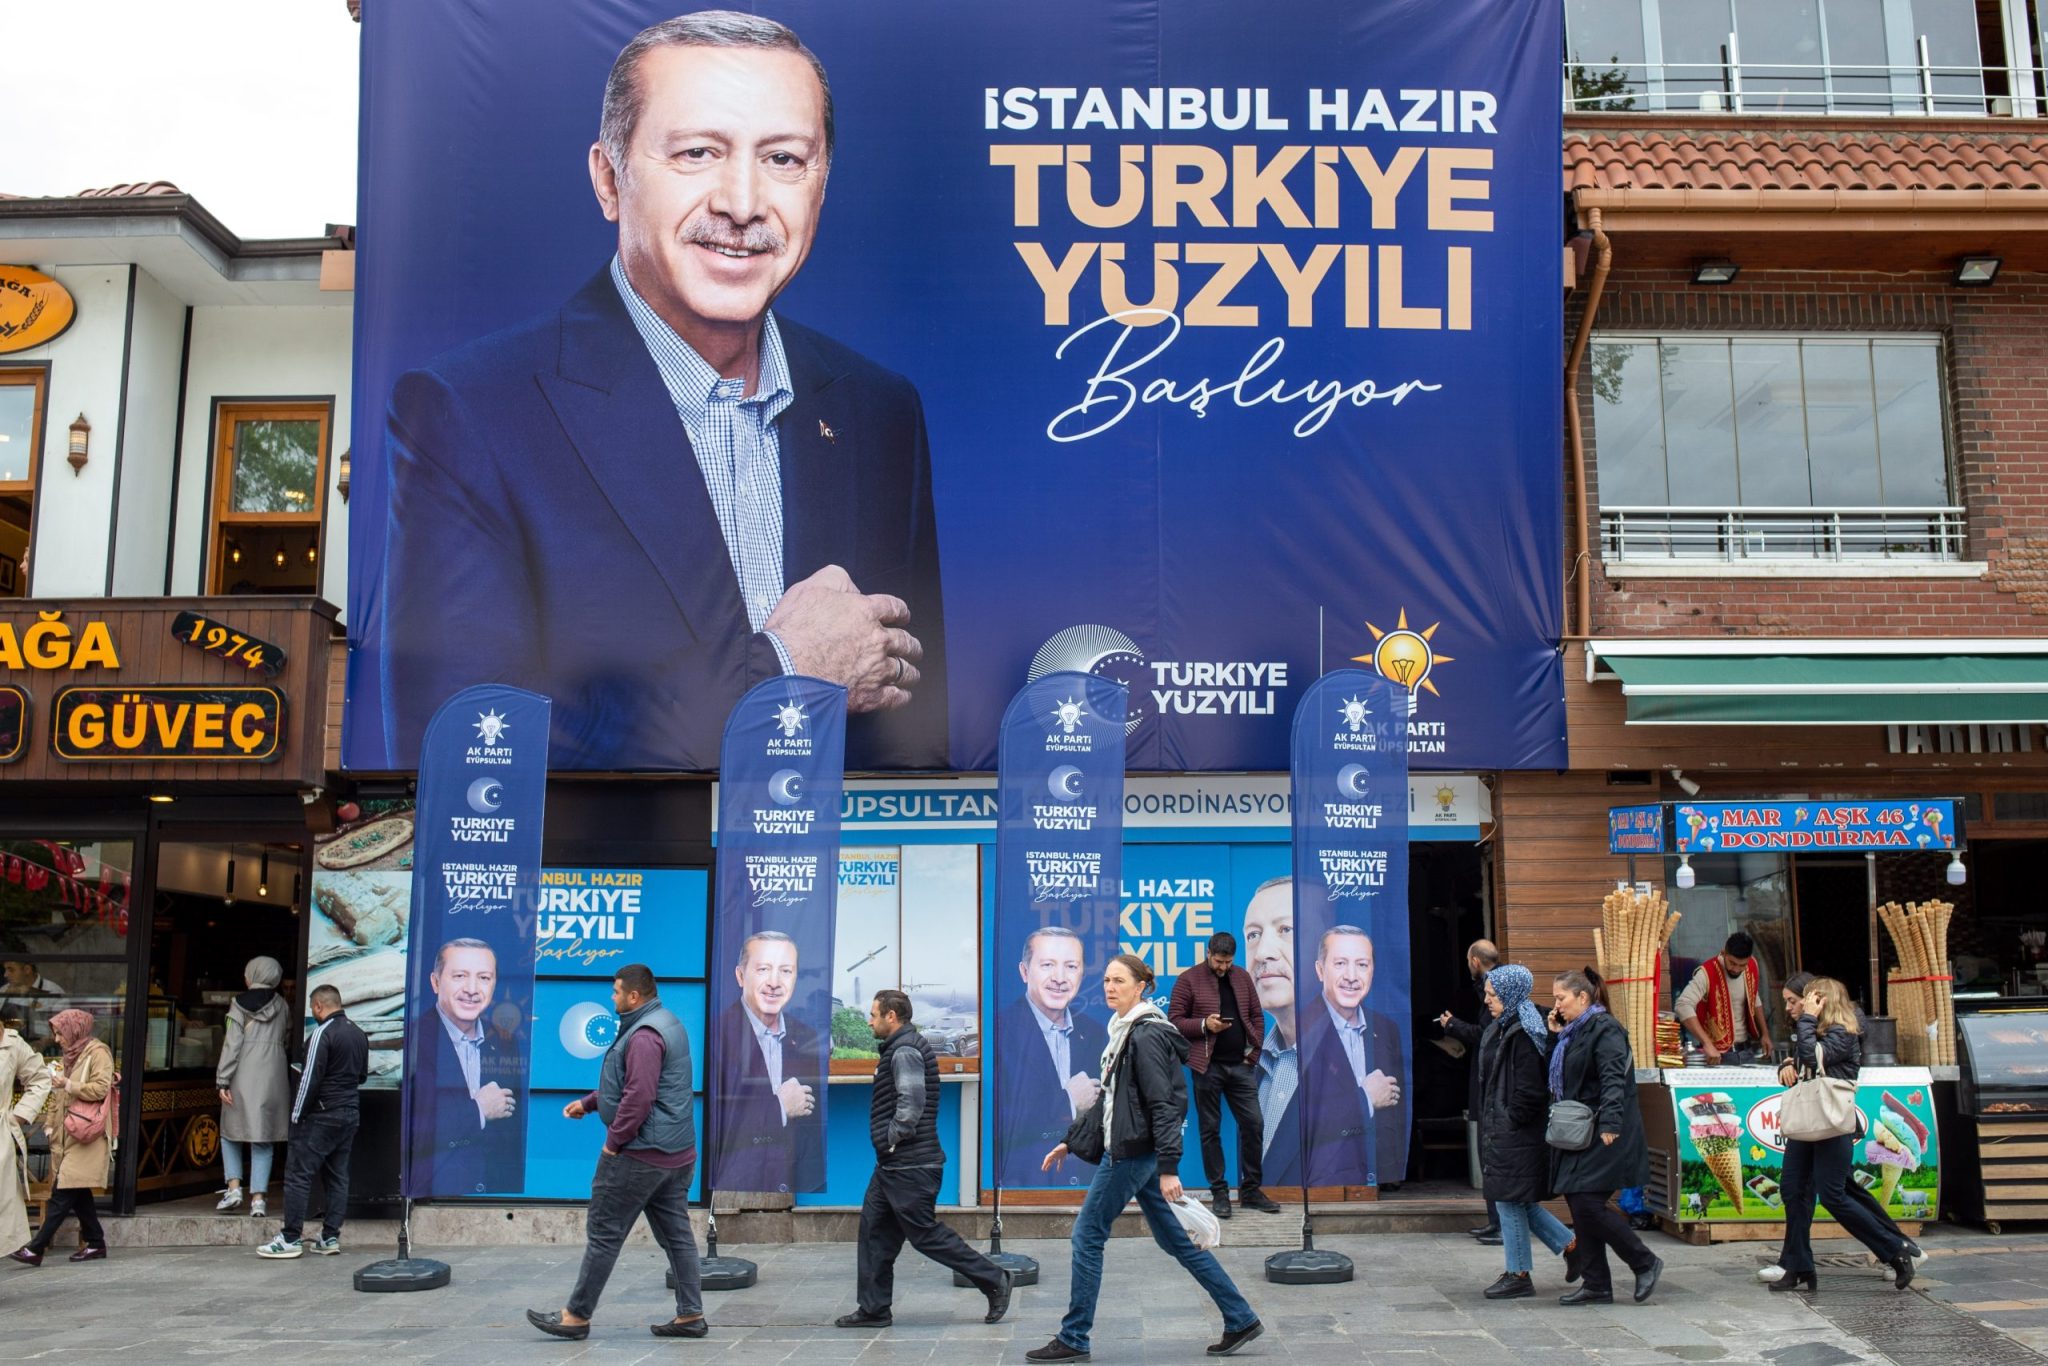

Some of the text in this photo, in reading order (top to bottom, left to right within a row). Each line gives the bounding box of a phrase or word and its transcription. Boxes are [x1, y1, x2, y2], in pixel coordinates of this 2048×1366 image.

[985, 87, 1498, 133] İSTANBUL HAZIR
[989, 144, 1494, 232] TÜRKİYE
[1013, 242, 1472, 330] YÜZYILI
[1047, 308, 1442, 443] Başlıyor
[190, 620, 264, 668] 1974
[1151, 661, 1288, 686] TÜRKİYE
[1151, 690, 1274, 715] YÜZYILI
[68, 694, 266, 753] GÜVEÇ
[767, 739, 812, 748] AK PARTİ
[1046, 735, 1091, 744] AK PARTİ
[1334, 733, 1376, 743] AK PARTİ
[467, 748, 512, 757] AK PARTİ
[754, 810, 815, 822] TÜRKİYE
[1033, 805, 1097, 818] TÜRKİYE
[1324, 804, 1382, 817] TÜRKİYE
[452, 817, 515, 830] TÜRKİYE
[1033, 818, 1090, 830] YÜZYILI
[1325, 816, 1376, 829] YÜZYILI
[1722, 808, 1904, 830] MAR AŞK 46
[754, 822, 809, 834] YÜZYILI
[451, 830, 508, 842] YÜZYILI
[1721, 830, 1910, 848] DONDURMA
[791, 856, 817, 864] HAZIR
[1072, 852, 1101, 860] HAZIR
[1360, 851, 1387, 859] HAZIR
[489, 864, 517, 872] HAZIR
[746, 864, 817, 877] TÜRKİYE
[1026, 860, 1101, 874] TÜRKİYE
[1319, 858, 1387, 873] TÜRKİYE
[443, 872, 517, 886] TÜRKİYE
[591, 873, 643, 886] HAZIR
[750, 878, 813, 892] YÜZYILI
[1030, 874, 1097, 888] YÜZYILI
[1323, 872, 1384, 886] YÜZYILI
[446, 885, 513, 900] YÜZYILI
[1139, 879, 1215, 897] HAZIR
